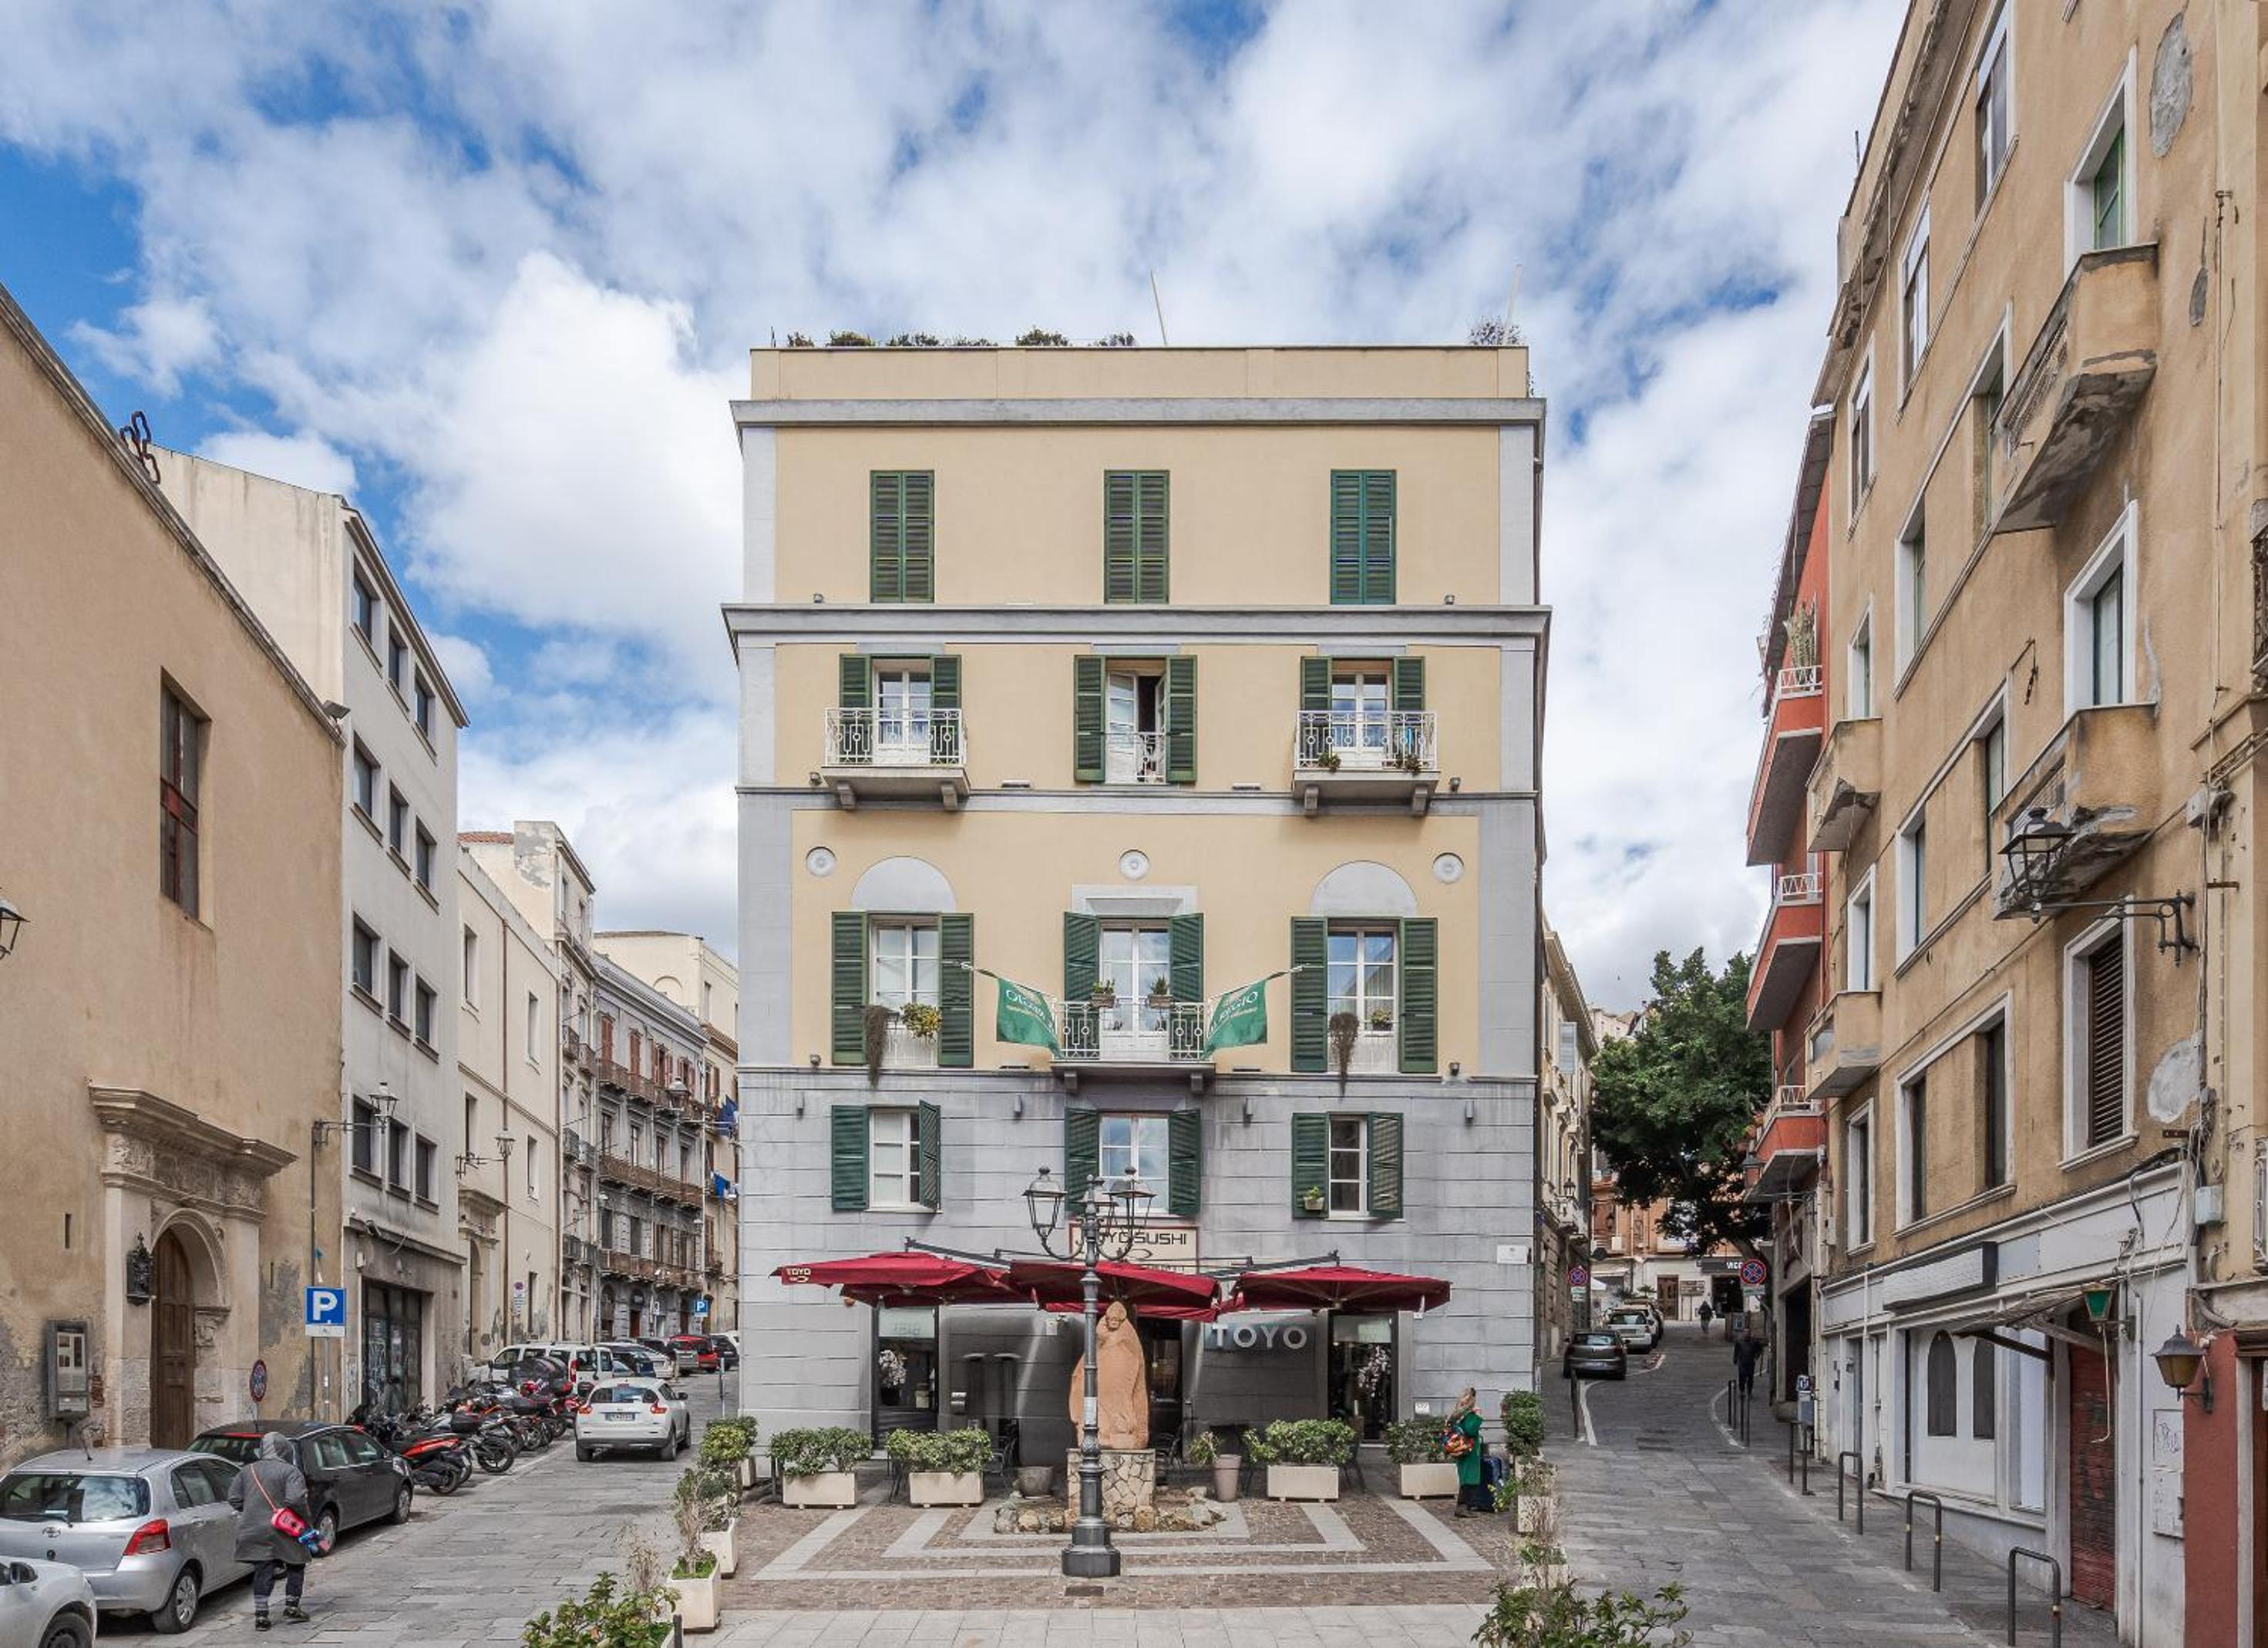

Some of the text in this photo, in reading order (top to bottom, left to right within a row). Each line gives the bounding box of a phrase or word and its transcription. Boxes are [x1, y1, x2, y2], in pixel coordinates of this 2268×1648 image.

[786, 1267, 811, 1276] TOYO
[312, 1290, 338, 1320] P
[696, 1301, 705, 1311] P
[1212, 1323, 1307, 1350] TOYO
